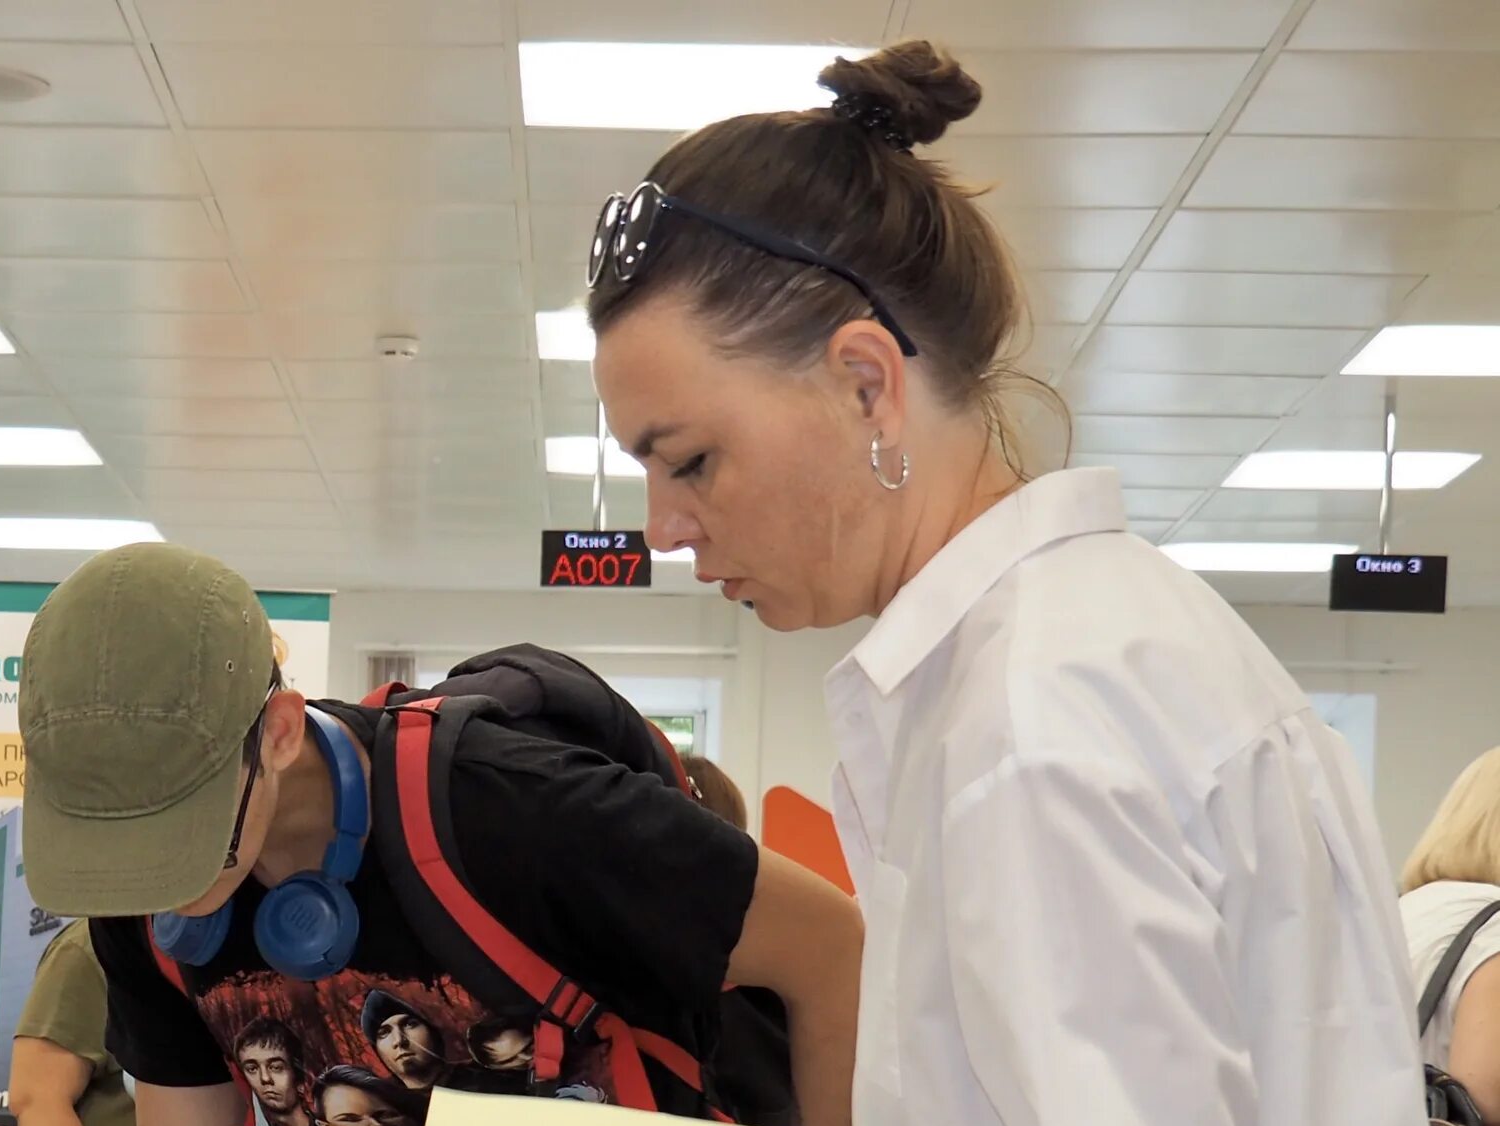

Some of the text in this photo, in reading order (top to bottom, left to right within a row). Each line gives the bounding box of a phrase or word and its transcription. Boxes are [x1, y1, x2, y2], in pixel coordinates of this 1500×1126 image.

[564, 533, 627, 549] Окно 2
[1356, 556, 1422, 573] Окно 3
